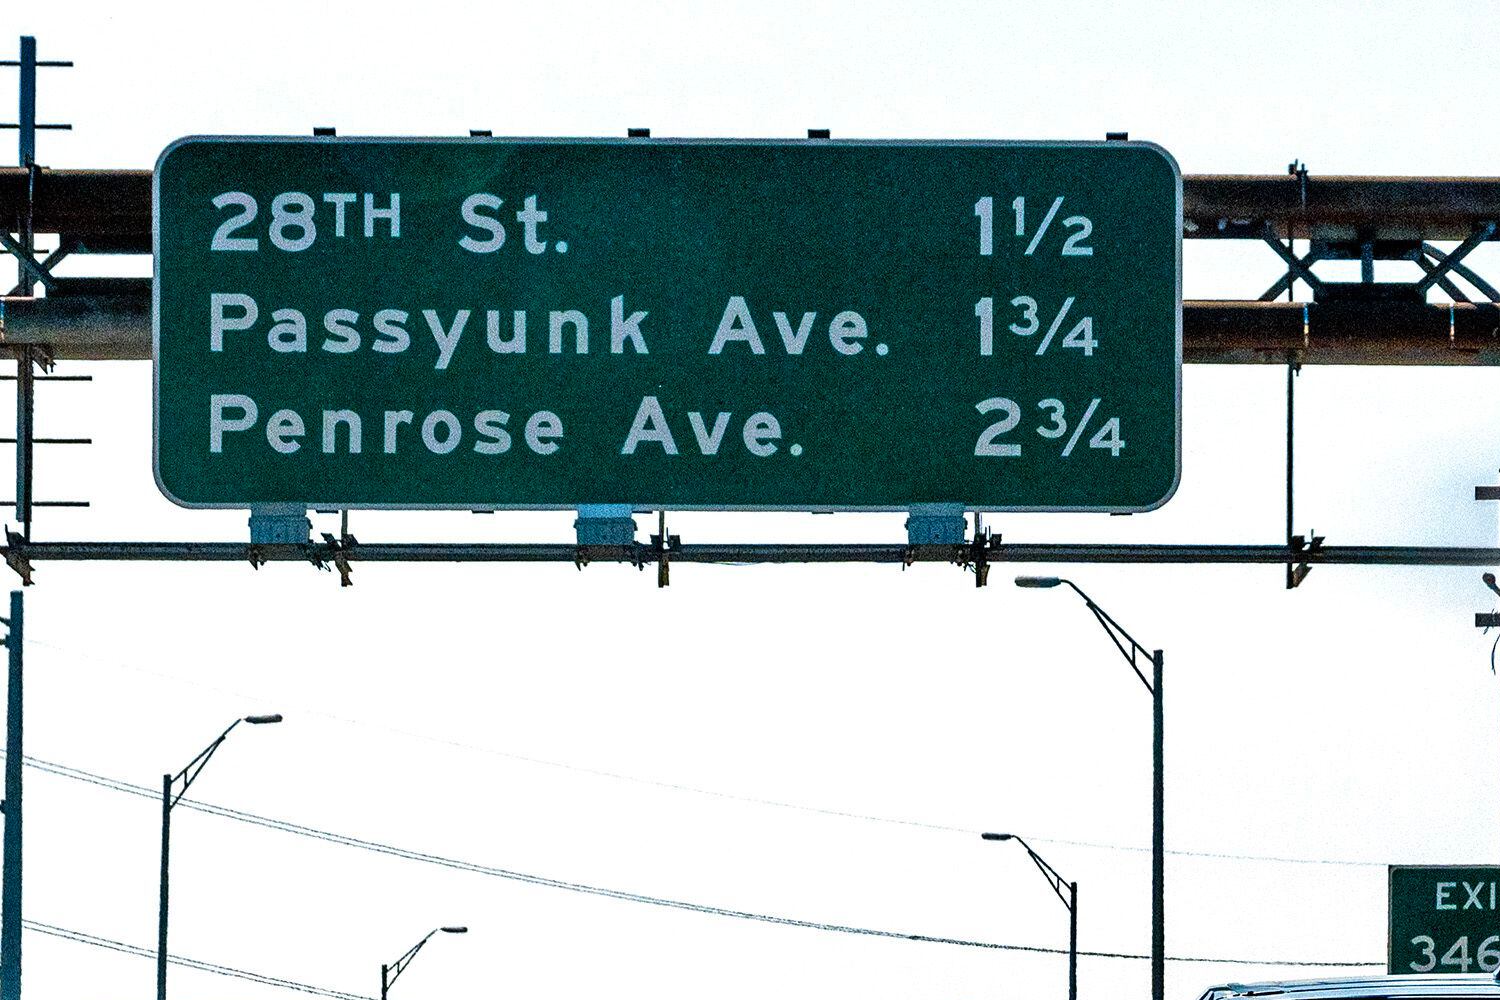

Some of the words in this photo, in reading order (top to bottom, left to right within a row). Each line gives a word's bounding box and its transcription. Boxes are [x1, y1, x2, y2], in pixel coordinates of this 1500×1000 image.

[211, 192, 401, 252] 28TH
[459, 193, 568, 254] St.
[210, 293, 649, 370] Passyunk
[708, 296, 889, 356] Ave.
[210, 394, 564, 454] Penrose
[621, 396, 803, 456] Ave.
